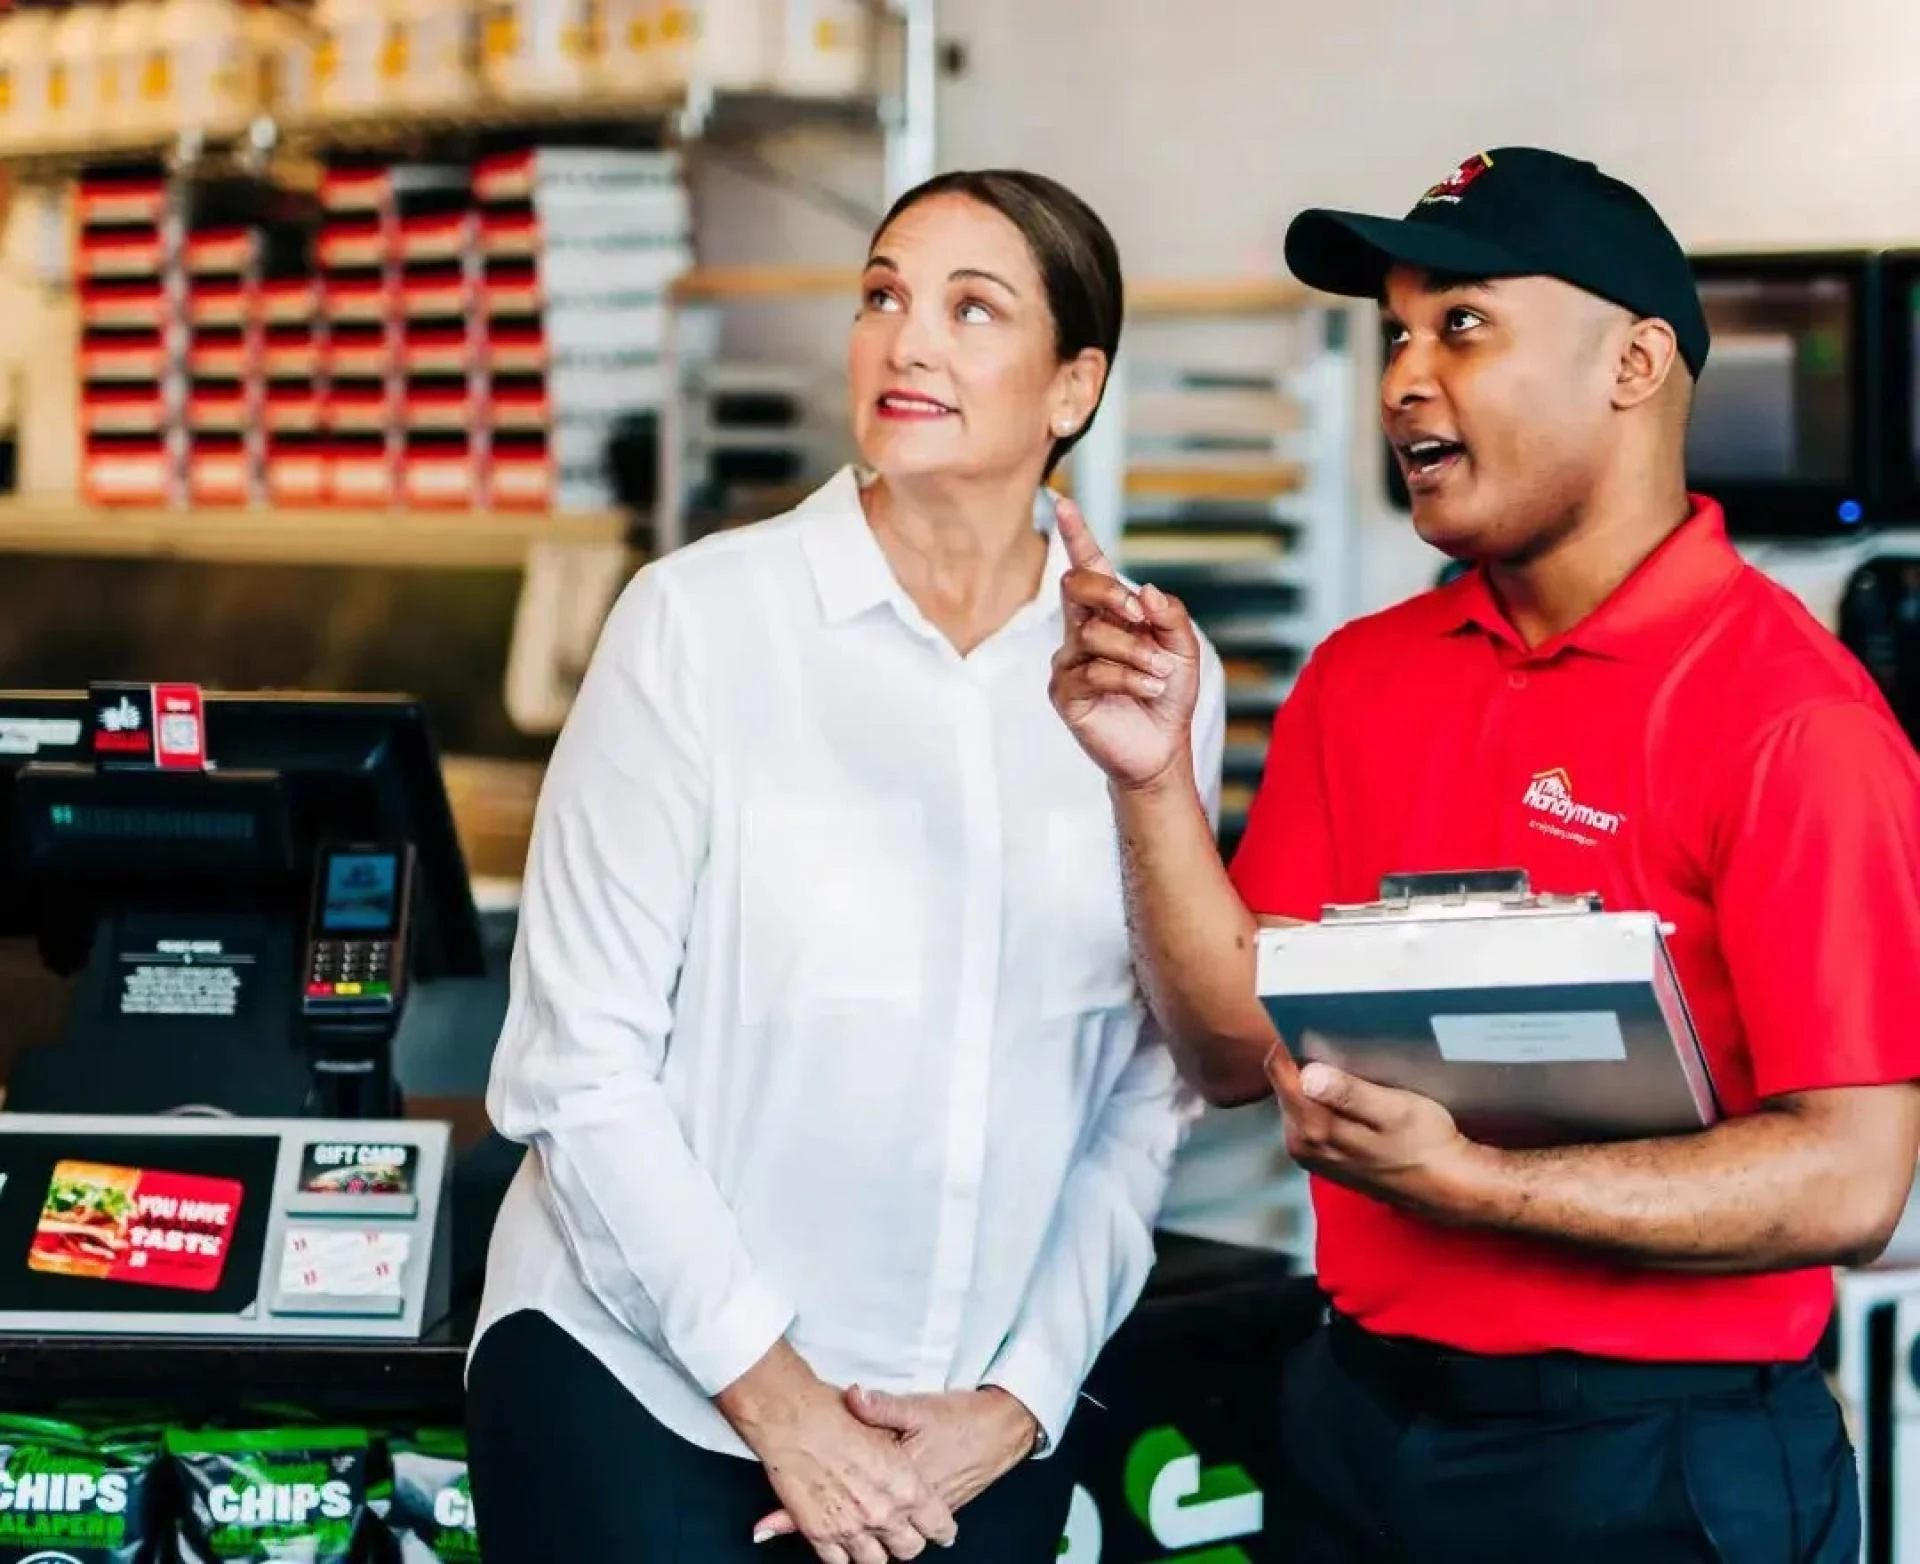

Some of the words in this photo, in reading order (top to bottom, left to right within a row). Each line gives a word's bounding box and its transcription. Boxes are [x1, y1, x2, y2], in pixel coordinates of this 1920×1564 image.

[1522, 780, 1619, 834] Handyman
[314, 1145, 356, 1164] GIFT
[138, 1194, 178, 1219] YOU
[178, 1198, 230, 1225] HAVE
[209, 1480, 352, 1522] CHIPS
